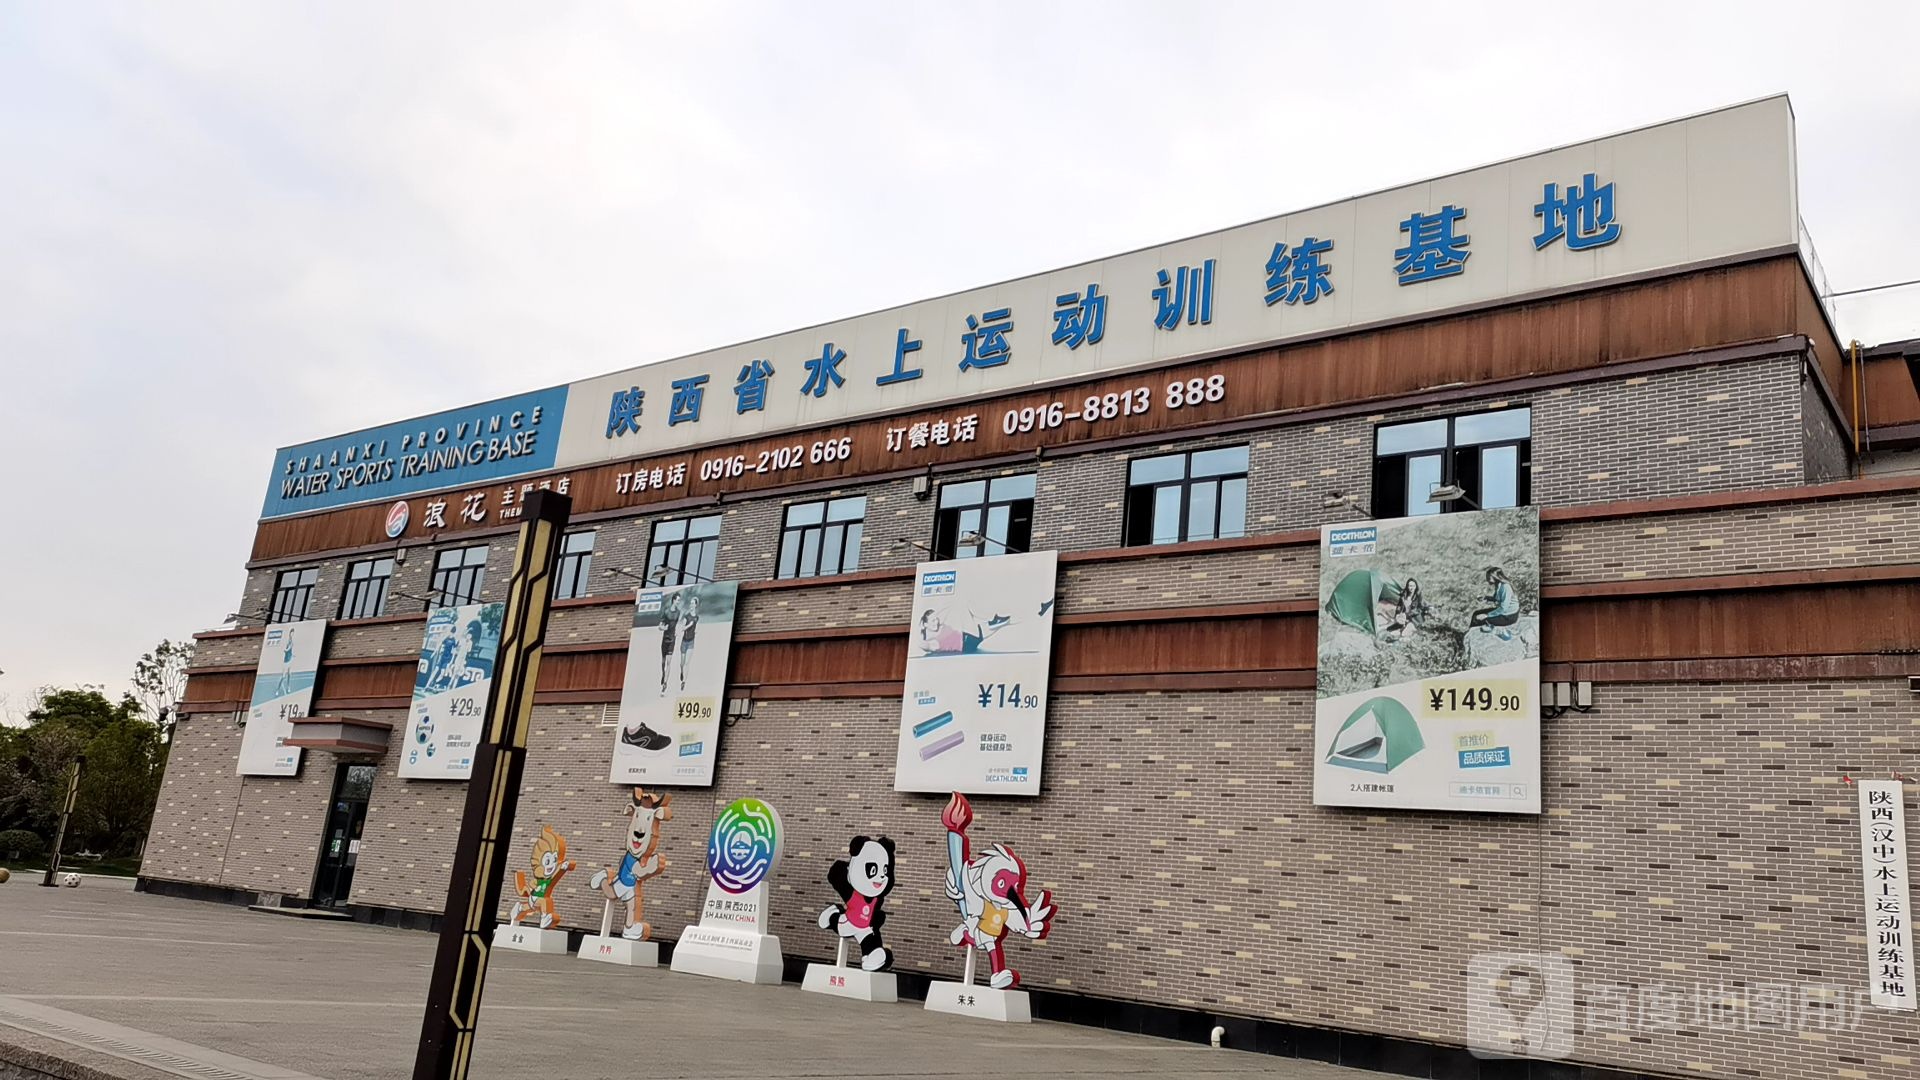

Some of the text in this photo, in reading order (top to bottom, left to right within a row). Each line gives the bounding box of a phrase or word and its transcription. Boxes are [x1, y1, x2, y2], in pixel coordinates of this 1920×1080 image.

[604, 172, 1622, 440] 陕西省水上运动训练基地
[885, 374, 1226, 452] 订餐电话 0916-8813 888
[285, 405, 544, 475] SHAANXI PROVINCE
[281, 430, 537, 499] WATER SPORTS TRAINING BASE
[615, 436, 852, 494] 订房电话 0916-2102 666
[423, 492, 487, 528] 浪花
[449, 698, 481, 717] ¥29.90
[677, 702, 712, 719] ¥99.90
[978, 683, 1038, 709] ¥14.90
[1429, 687, 1520, 712] ¥149.90
[1463, 750, 1506, 765] 品质保证
